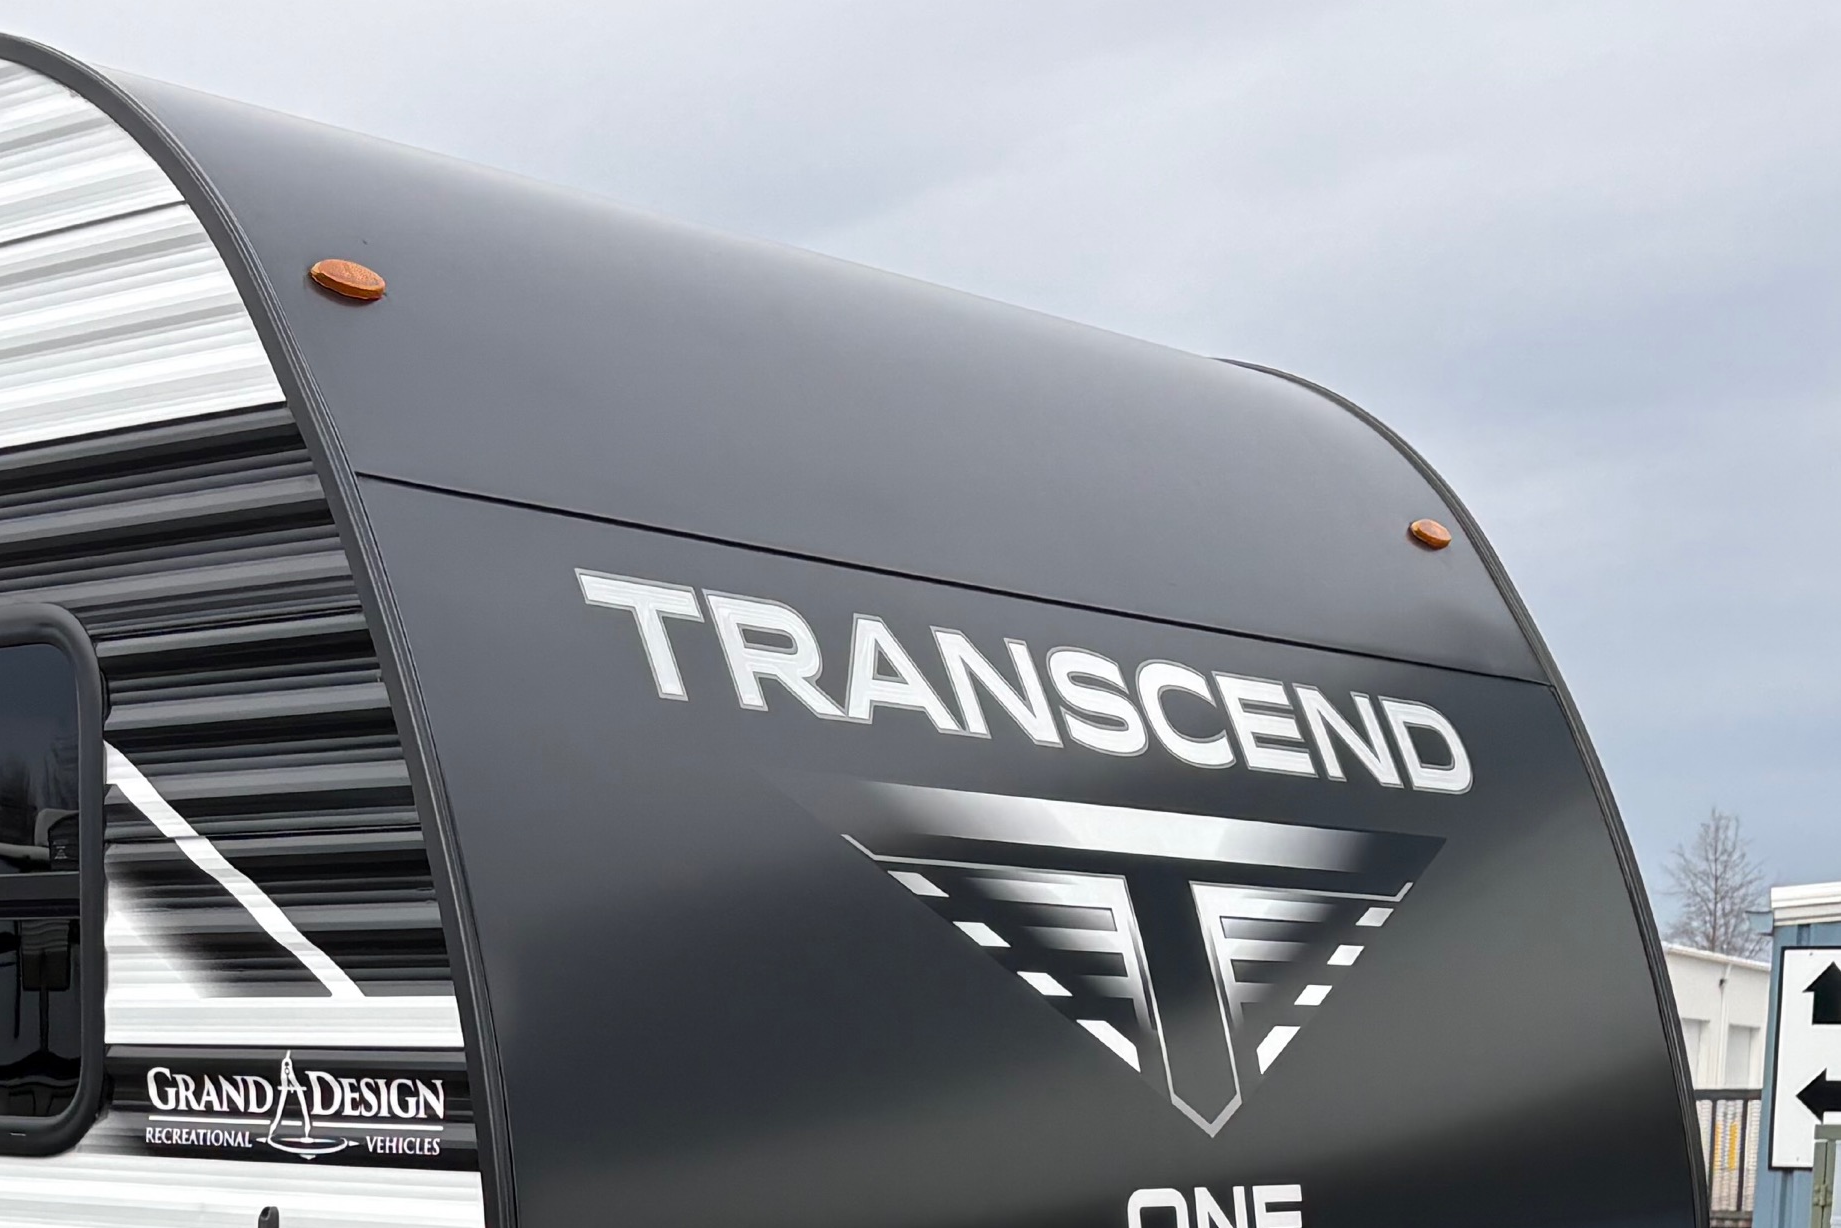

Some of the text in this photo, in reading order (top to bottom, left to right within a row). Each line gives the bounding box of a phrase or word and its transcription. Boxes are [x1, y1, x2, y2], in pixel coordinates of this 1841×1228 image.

[574, 567, 1474, 795] TRANSCEND
[146, 1066, 444, 1119] GRAND DESIGN
[145, 1127, 440, 1155] RECREATIONAL VEHICLES
